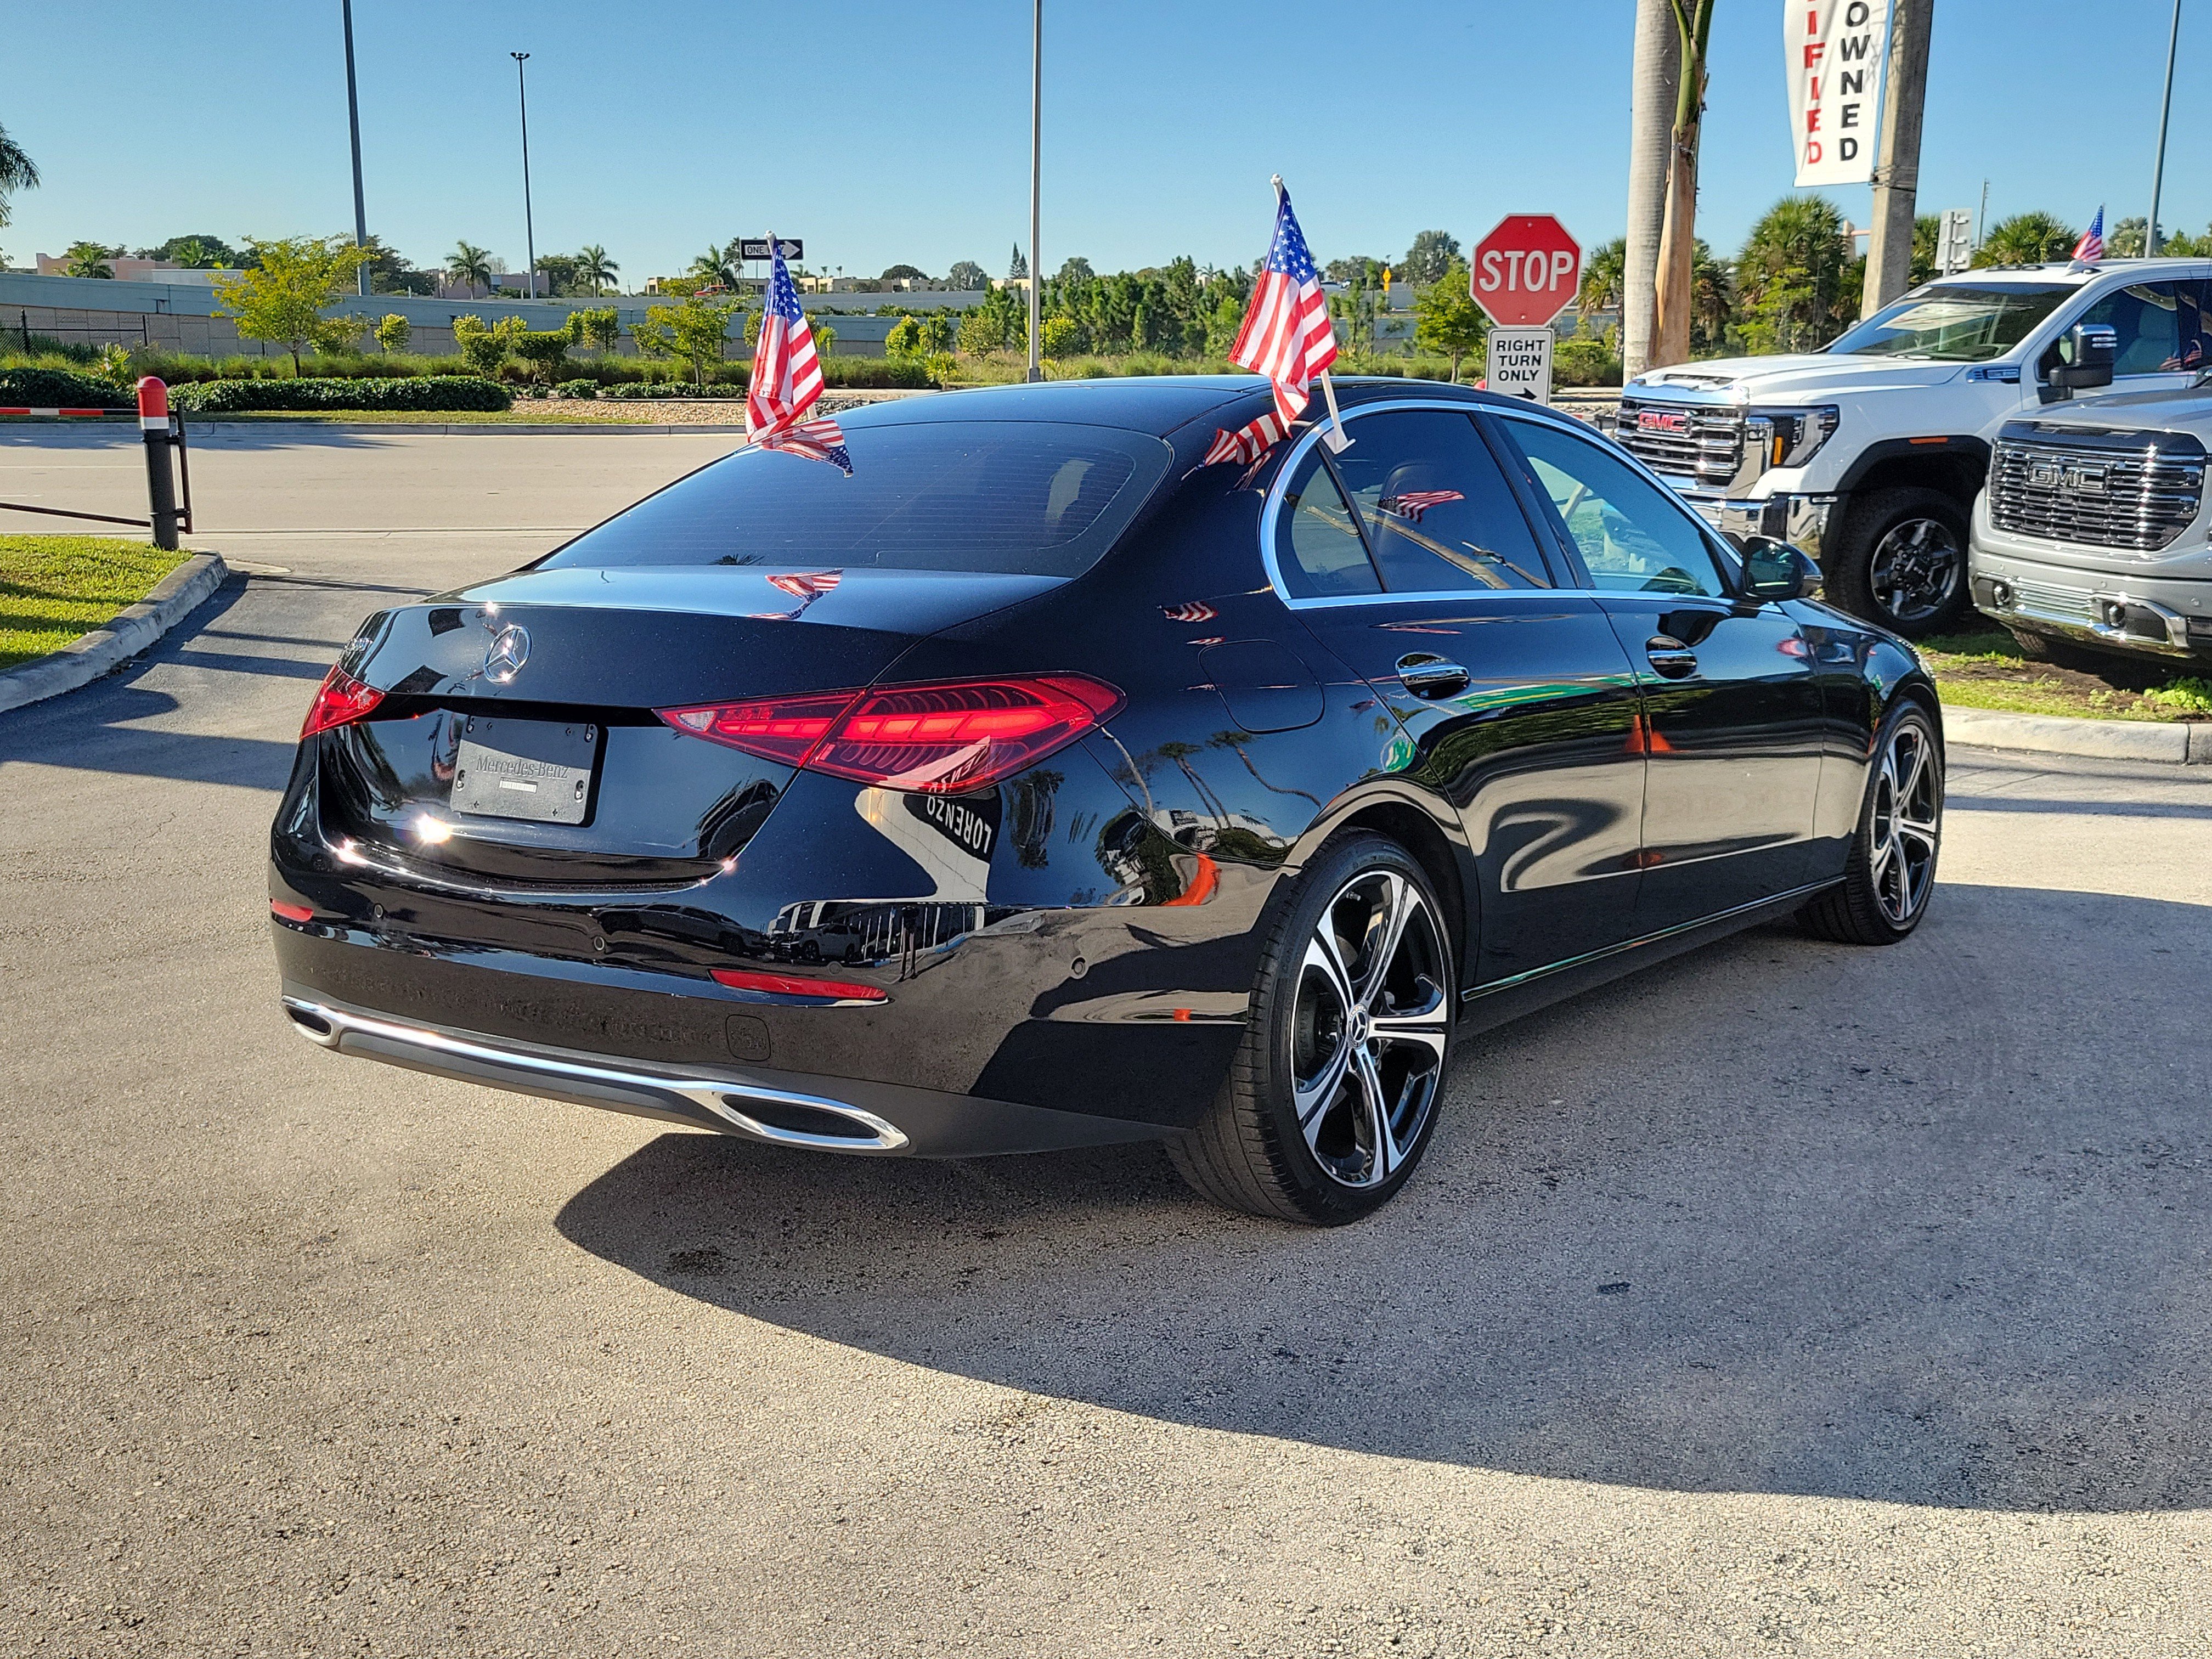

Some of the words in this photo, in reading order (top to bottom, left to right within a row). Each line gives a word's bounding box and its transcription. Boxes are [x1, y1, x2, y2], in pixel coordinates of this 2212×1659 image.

[1803, 0, 1825, 164] IFIED
[1840, 2, 1871, 161] OWNED
[747, 246, 764, 254] ONE
[1479, 250, 1575, 292] STOP
[1496, 340, 1546, 351] RIGHT
[1498, 354, 1542, 366] TURN
[1498, 370, 1539, 381] ONLY
[1639, 413, 1686, 431] GMC
[2029, 464, 2105, 490] GMC
[475, 755, 569, 780] Mercedes-Benz
[927, 795, 992, 854] LORENZO
